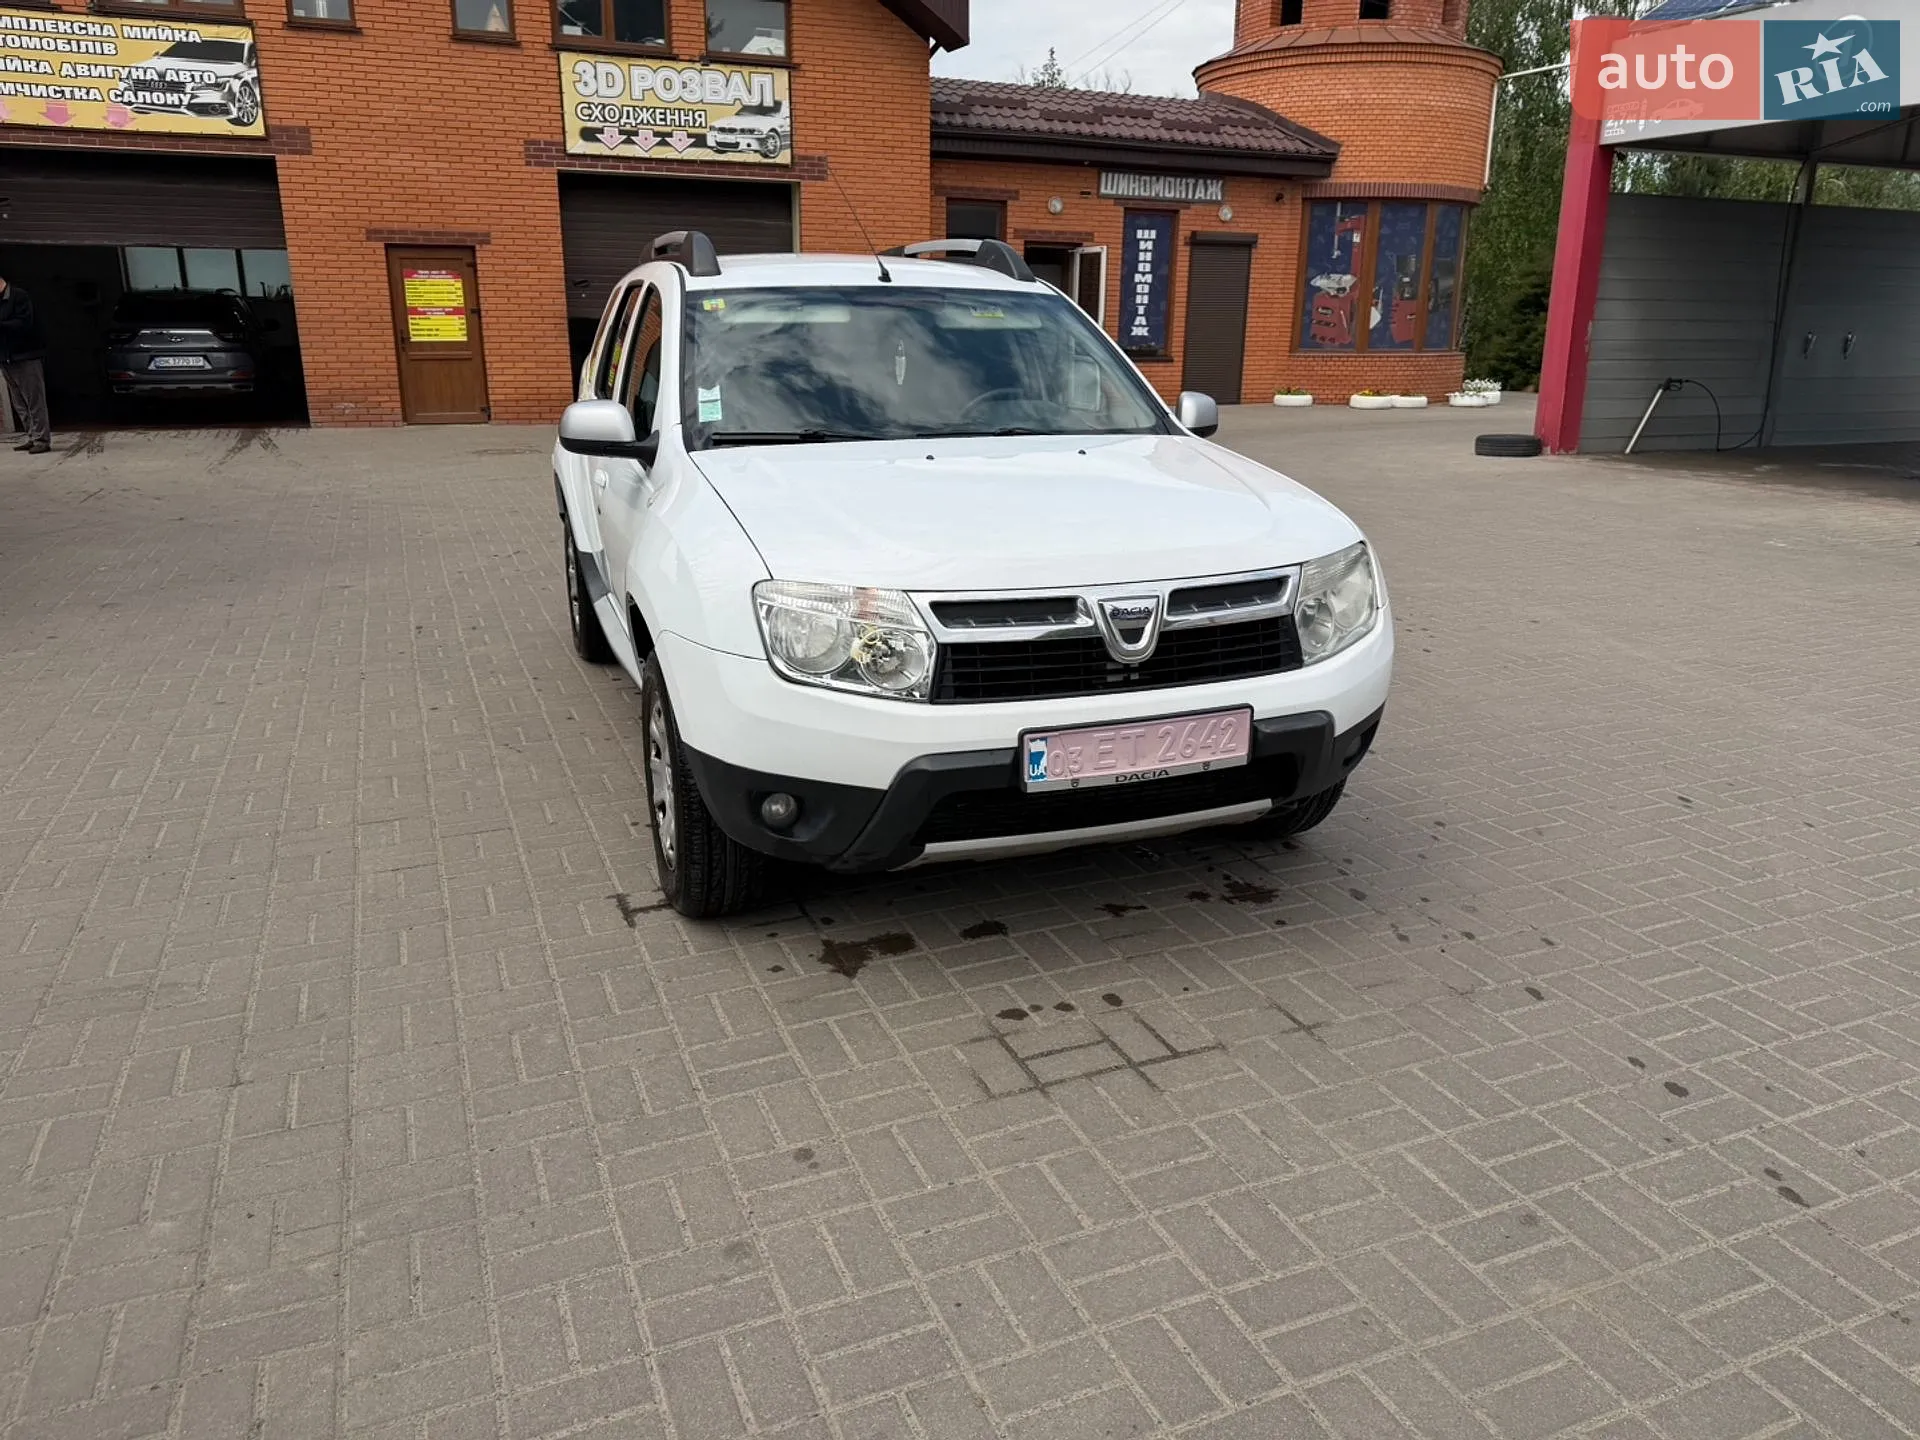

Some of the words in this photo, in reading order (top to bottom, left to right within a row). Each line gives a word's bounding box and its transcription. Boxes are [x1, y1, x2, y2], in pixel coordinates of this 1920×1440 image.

[122, 25, 201, 43] МИЙКА
[60, 61, 158, 81] ДВИГУНА
[165, 68, 216, 83] АВТО
[573, 61, 625, 98] 3D
[629, 64, 774, 107] РОЗВАЛ
[108, 88, 192, 105] САЛОНУ
[575, 102, 707, 128] СХОДЖЕННЯ
[1101, 172, 1223, 200] ШИНОМОНТАЖ
[1131, 229, 1157, 336] ШИНОМОНТАЖ
[1111, 606, 1153, 619] DACIA
[1049, 746, 1084, 776] 03
[1093, 729, 1145, 770] ET
[1157, 717, 1238, 763] 2642
[1029, 764, 1047, 776] UA
[1115, 768, 1170, 783] DACIA
